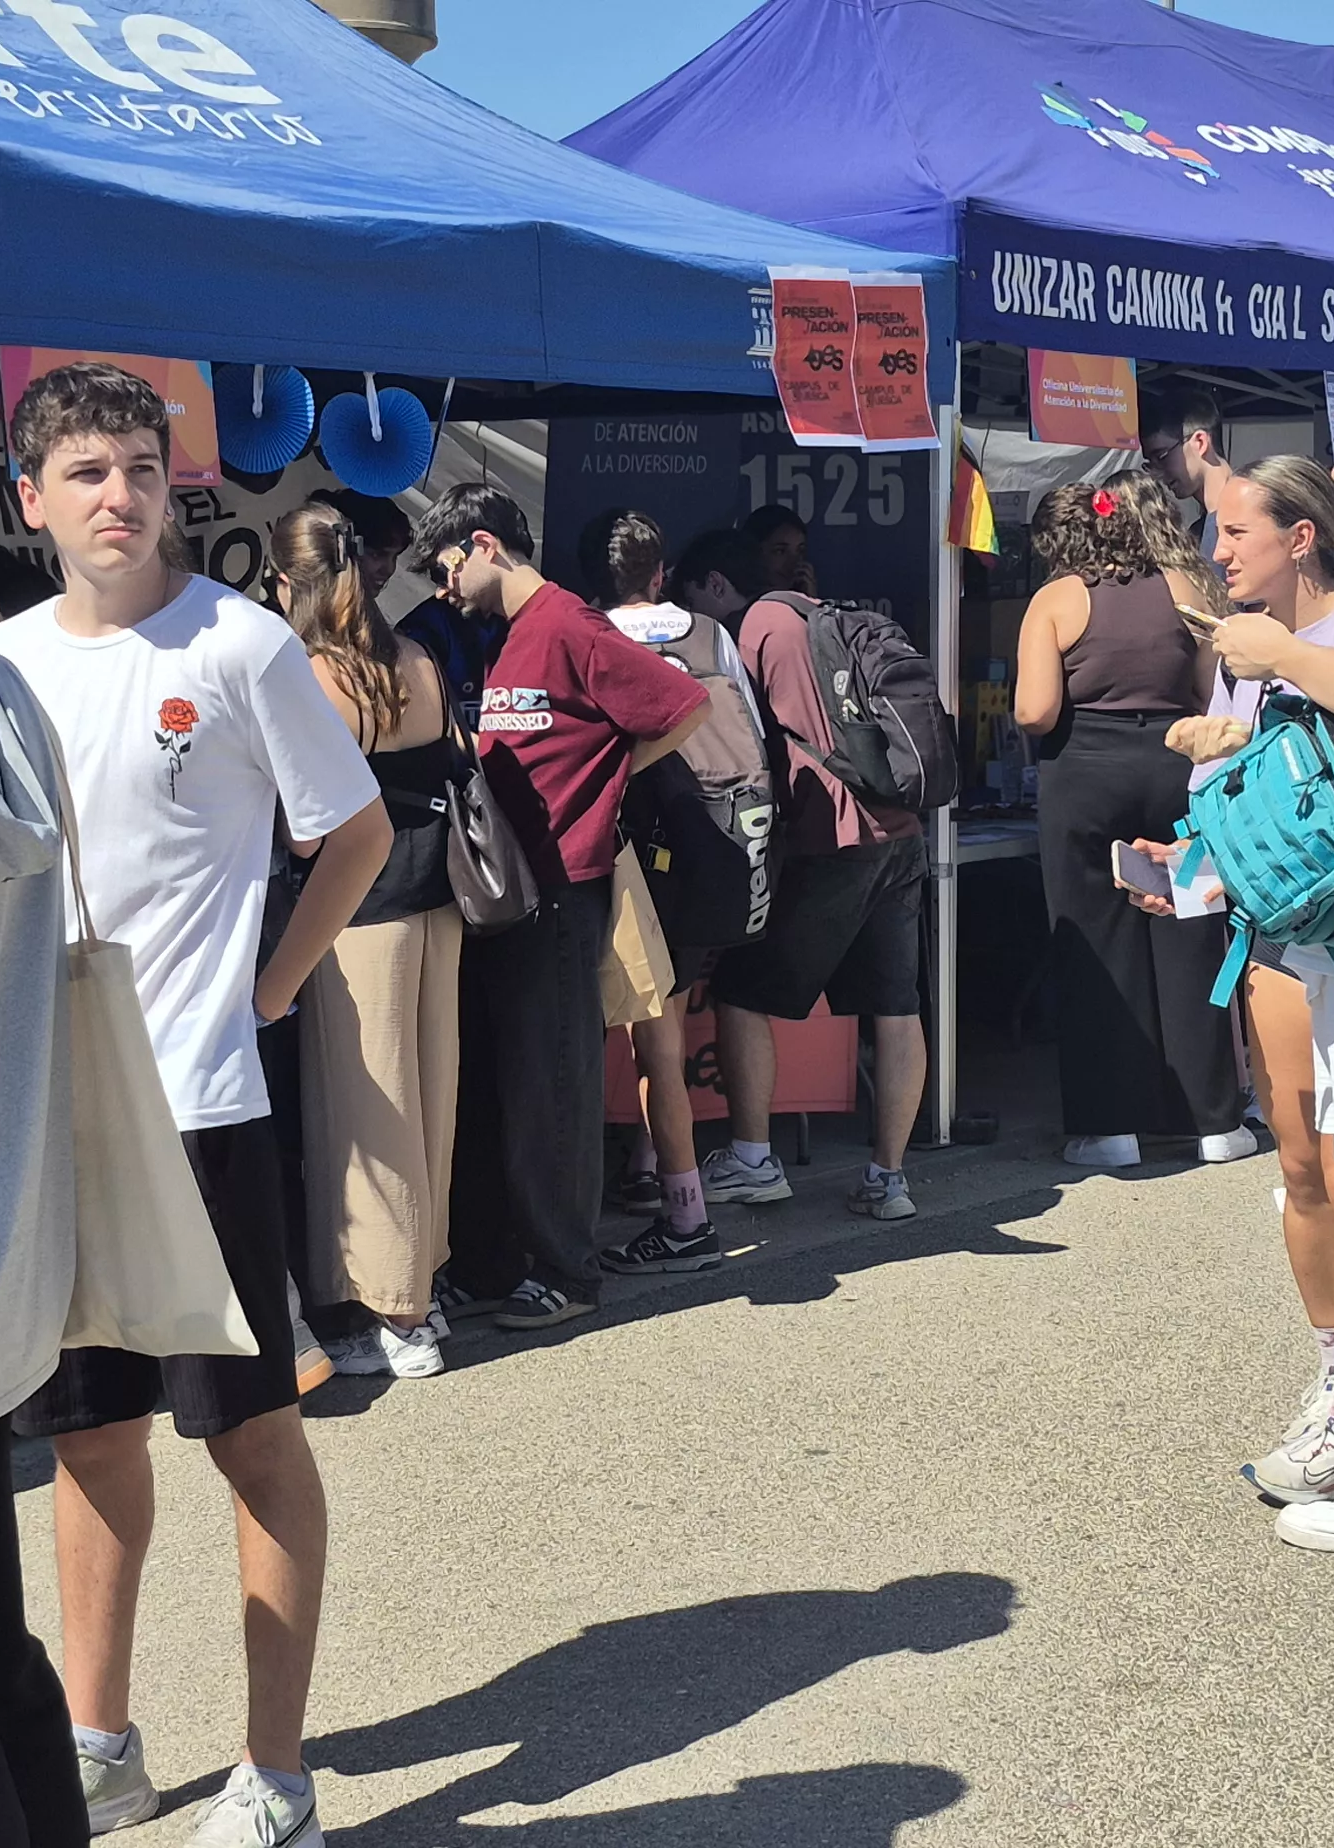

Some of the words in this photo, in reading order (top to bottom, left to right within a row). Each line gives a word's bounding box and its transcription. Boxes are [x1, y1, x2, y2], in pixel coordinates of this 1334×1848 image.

[991, 250, 1097, 323] UNIZAR
[1106, 264, 1209, 333] CAMINA
[594, 422, 614, 443] DE
[617, 419, 698, 444] ATENCIÓN
[581, 455, 592, 472] A
[595, 455, 614, 474] LA
[617, 454, 708, 475] DIVERSIDAD
[740, 454, 905, 527] 1525
